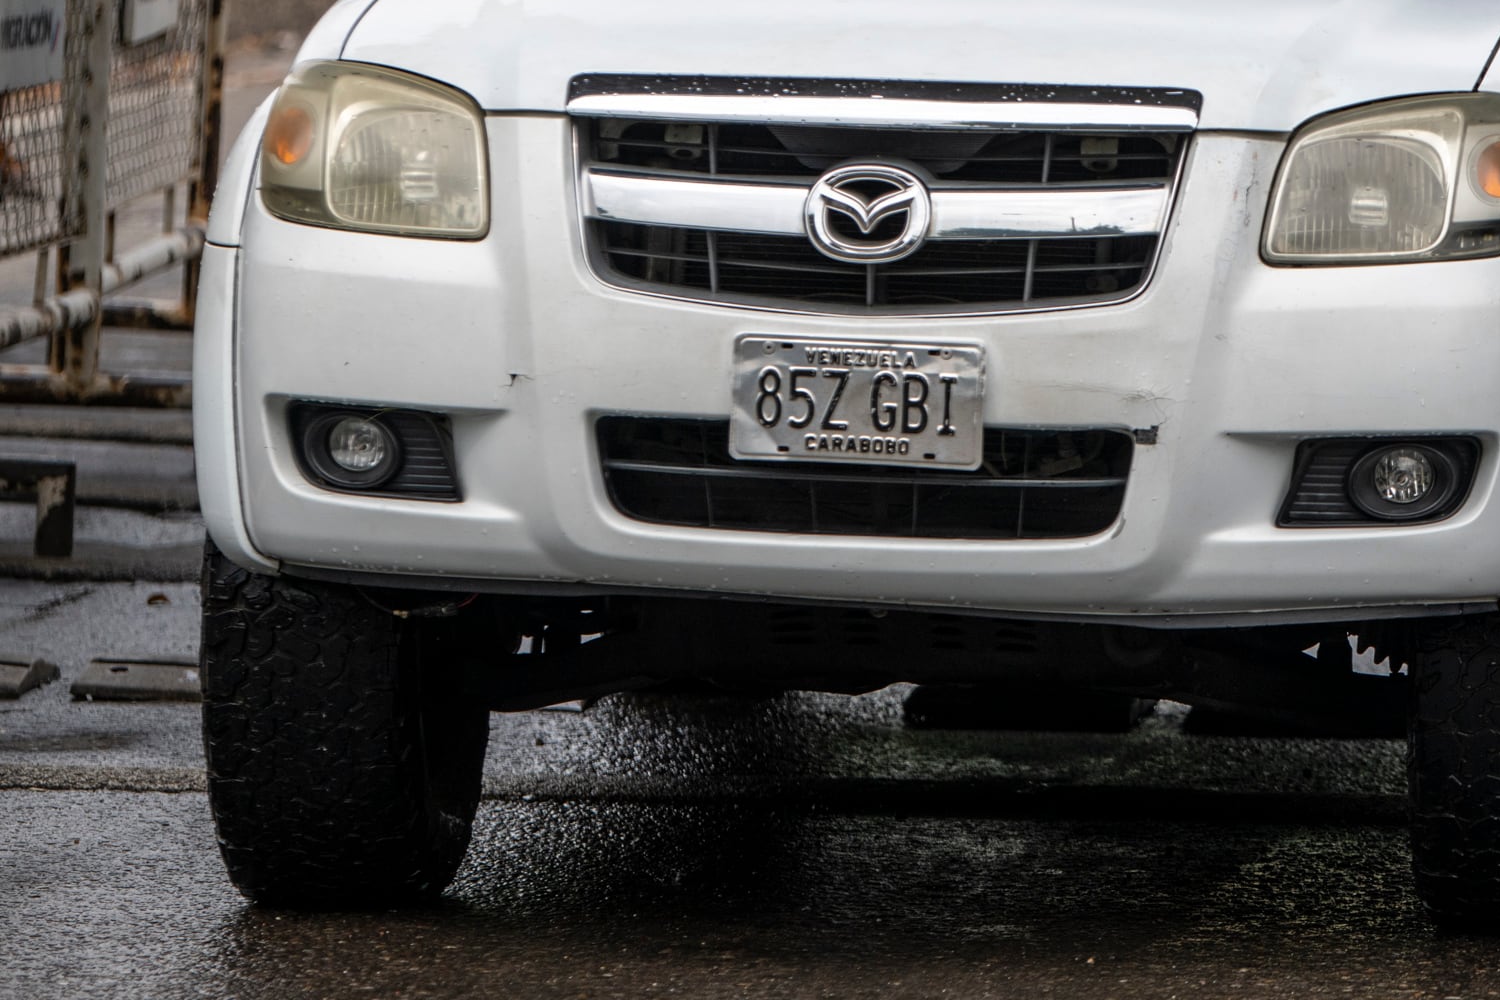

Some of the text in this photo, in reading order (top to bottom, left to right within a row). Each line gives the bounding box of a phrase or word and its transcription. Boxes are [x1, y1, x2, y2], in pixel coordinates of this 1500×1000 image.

[804, 345, 918, 370] VENEZUELA
[756, 366, 958, 436] 85Z GBI
[803, 433, 911, 456] CARABOBO
